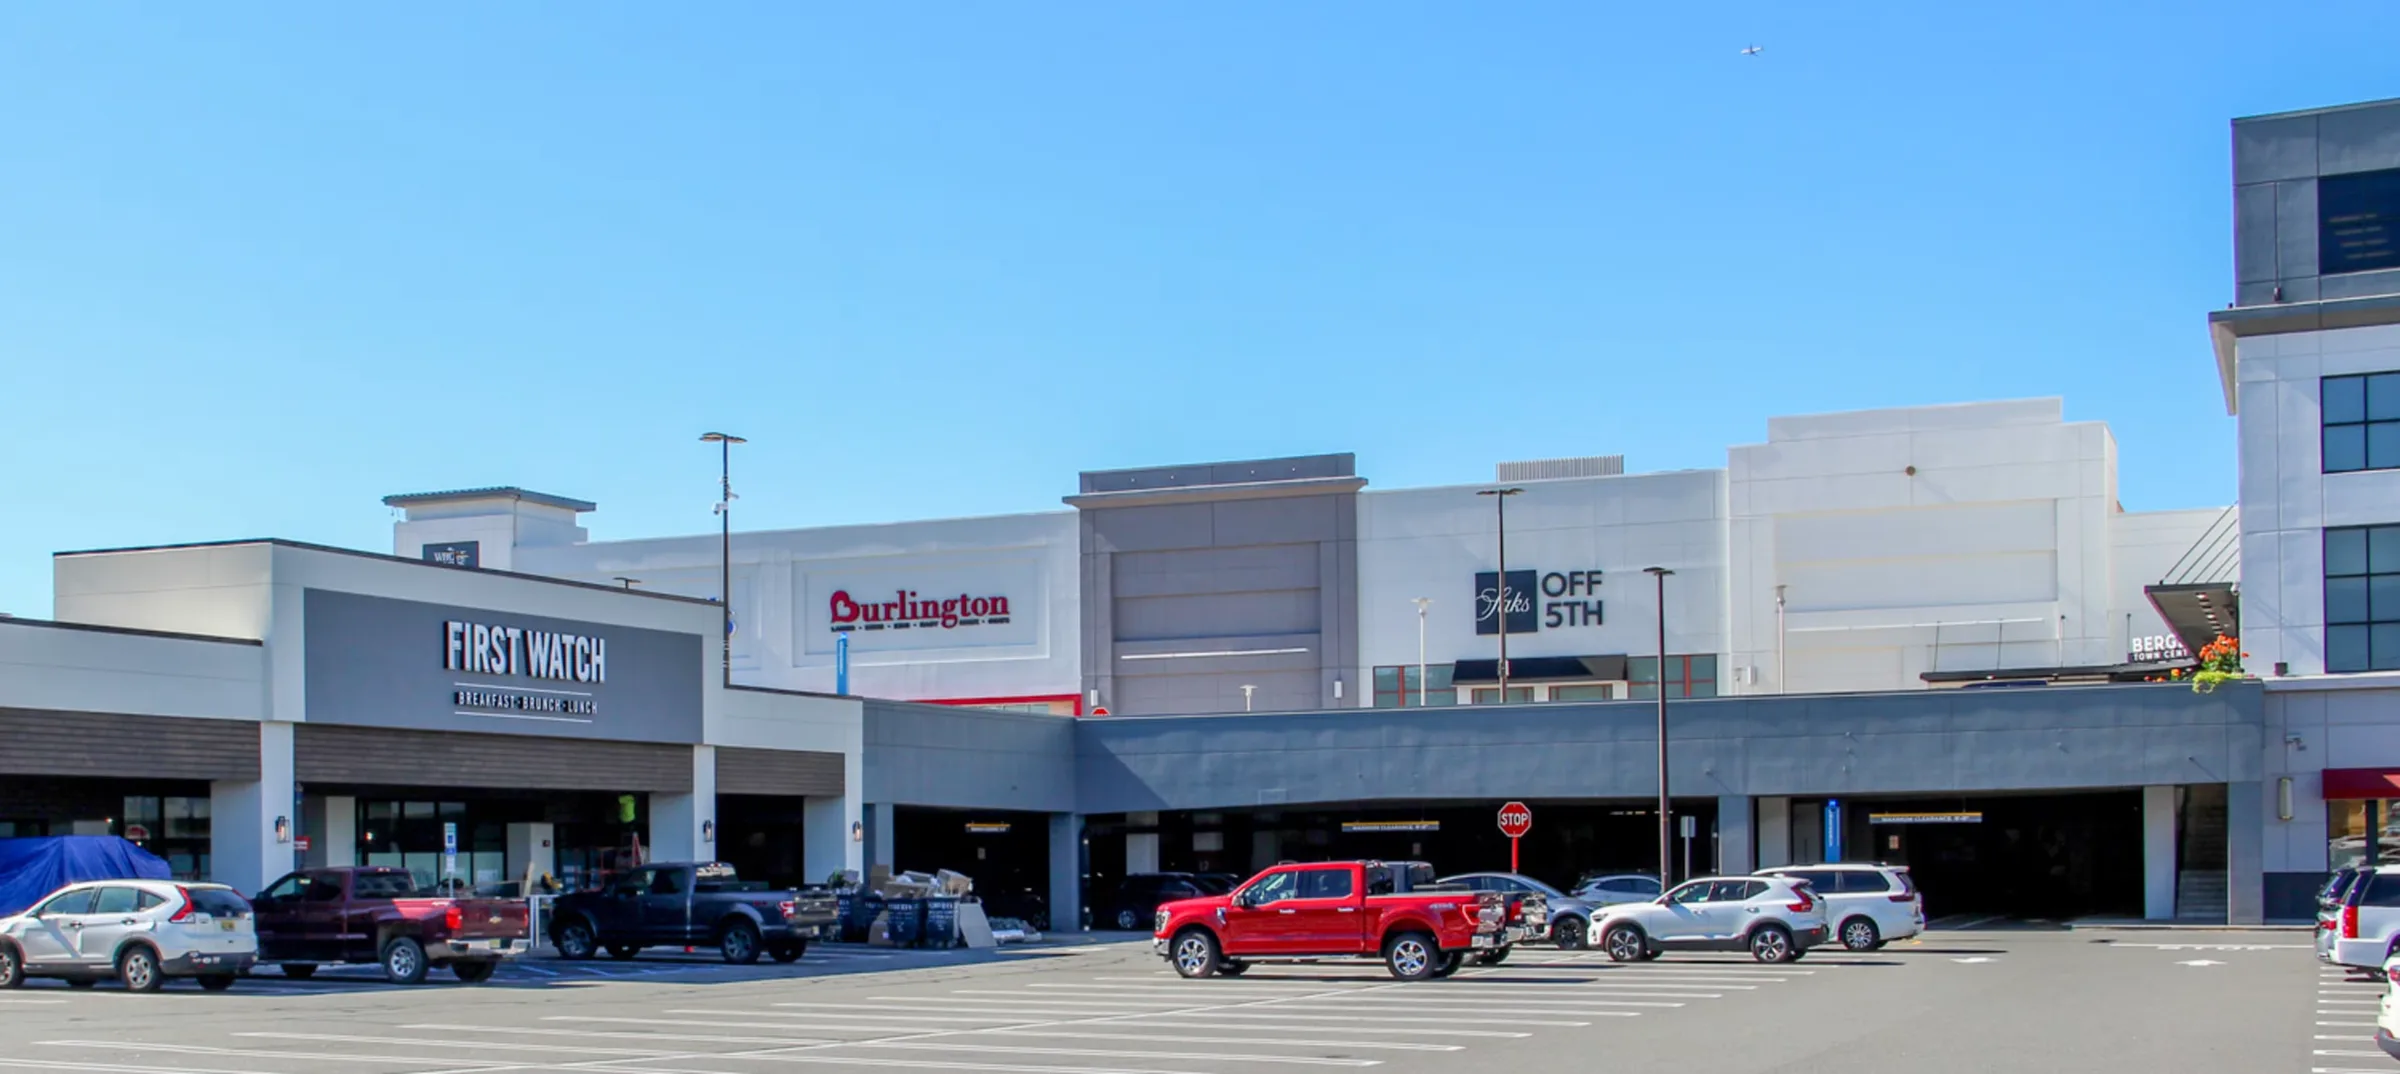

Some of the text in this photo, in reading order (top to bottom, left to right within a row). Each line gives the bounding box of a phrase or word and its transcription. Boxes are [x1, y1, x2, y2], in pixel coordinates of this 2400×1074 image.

[1541, 570, 1603, 597] OFF
[830, 589, 1010, 628] Burlington
[1545, 600, 1603, 628] 5TH
[446, 620, 606, 683] FIRST WATCH
[2132, 634, 2185, 653] BERG
[2133, 651, 2161, 661] TOWN
[457, 690, 598, 715] BREAKFAST BRUNCH LUNCH
[1501, 813, 1528, 826] STOP
